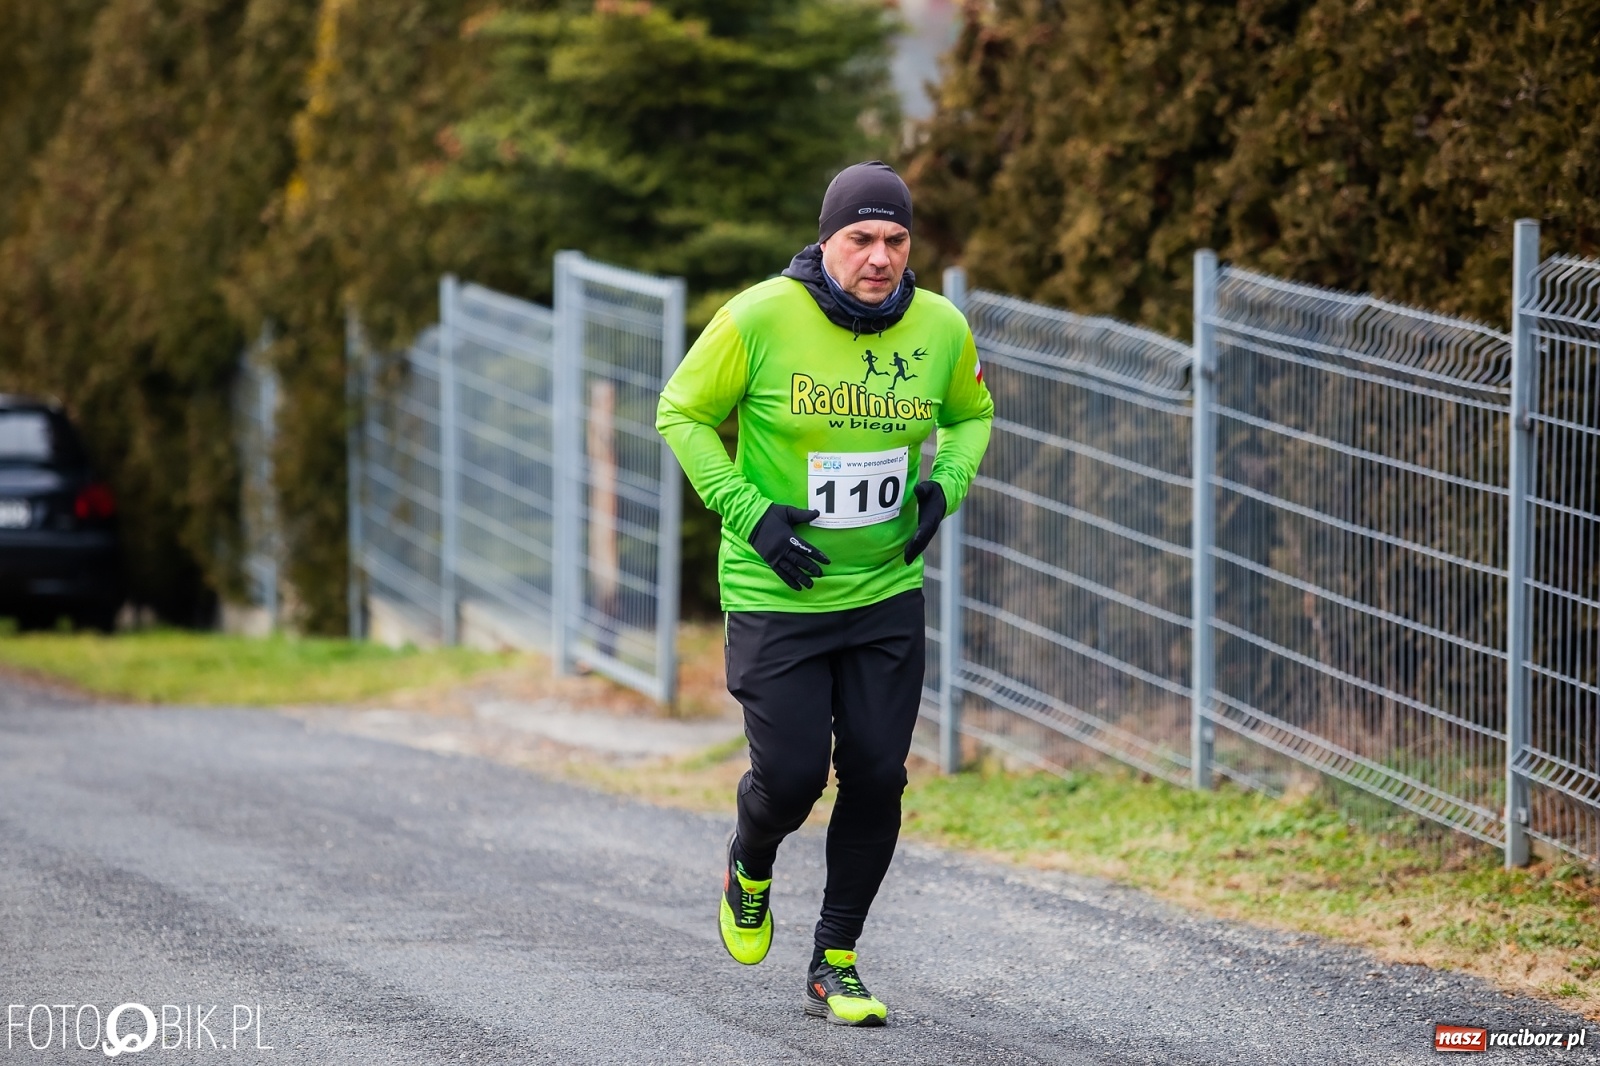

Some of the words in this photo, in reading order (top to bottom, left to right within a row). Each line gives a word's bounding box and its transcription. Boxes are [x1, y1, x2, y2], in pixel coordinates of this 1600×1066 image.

[828, 420, 844, 429] w
[850, 418, 907, 433] biegu
[816, 476, 900, 513] 110
